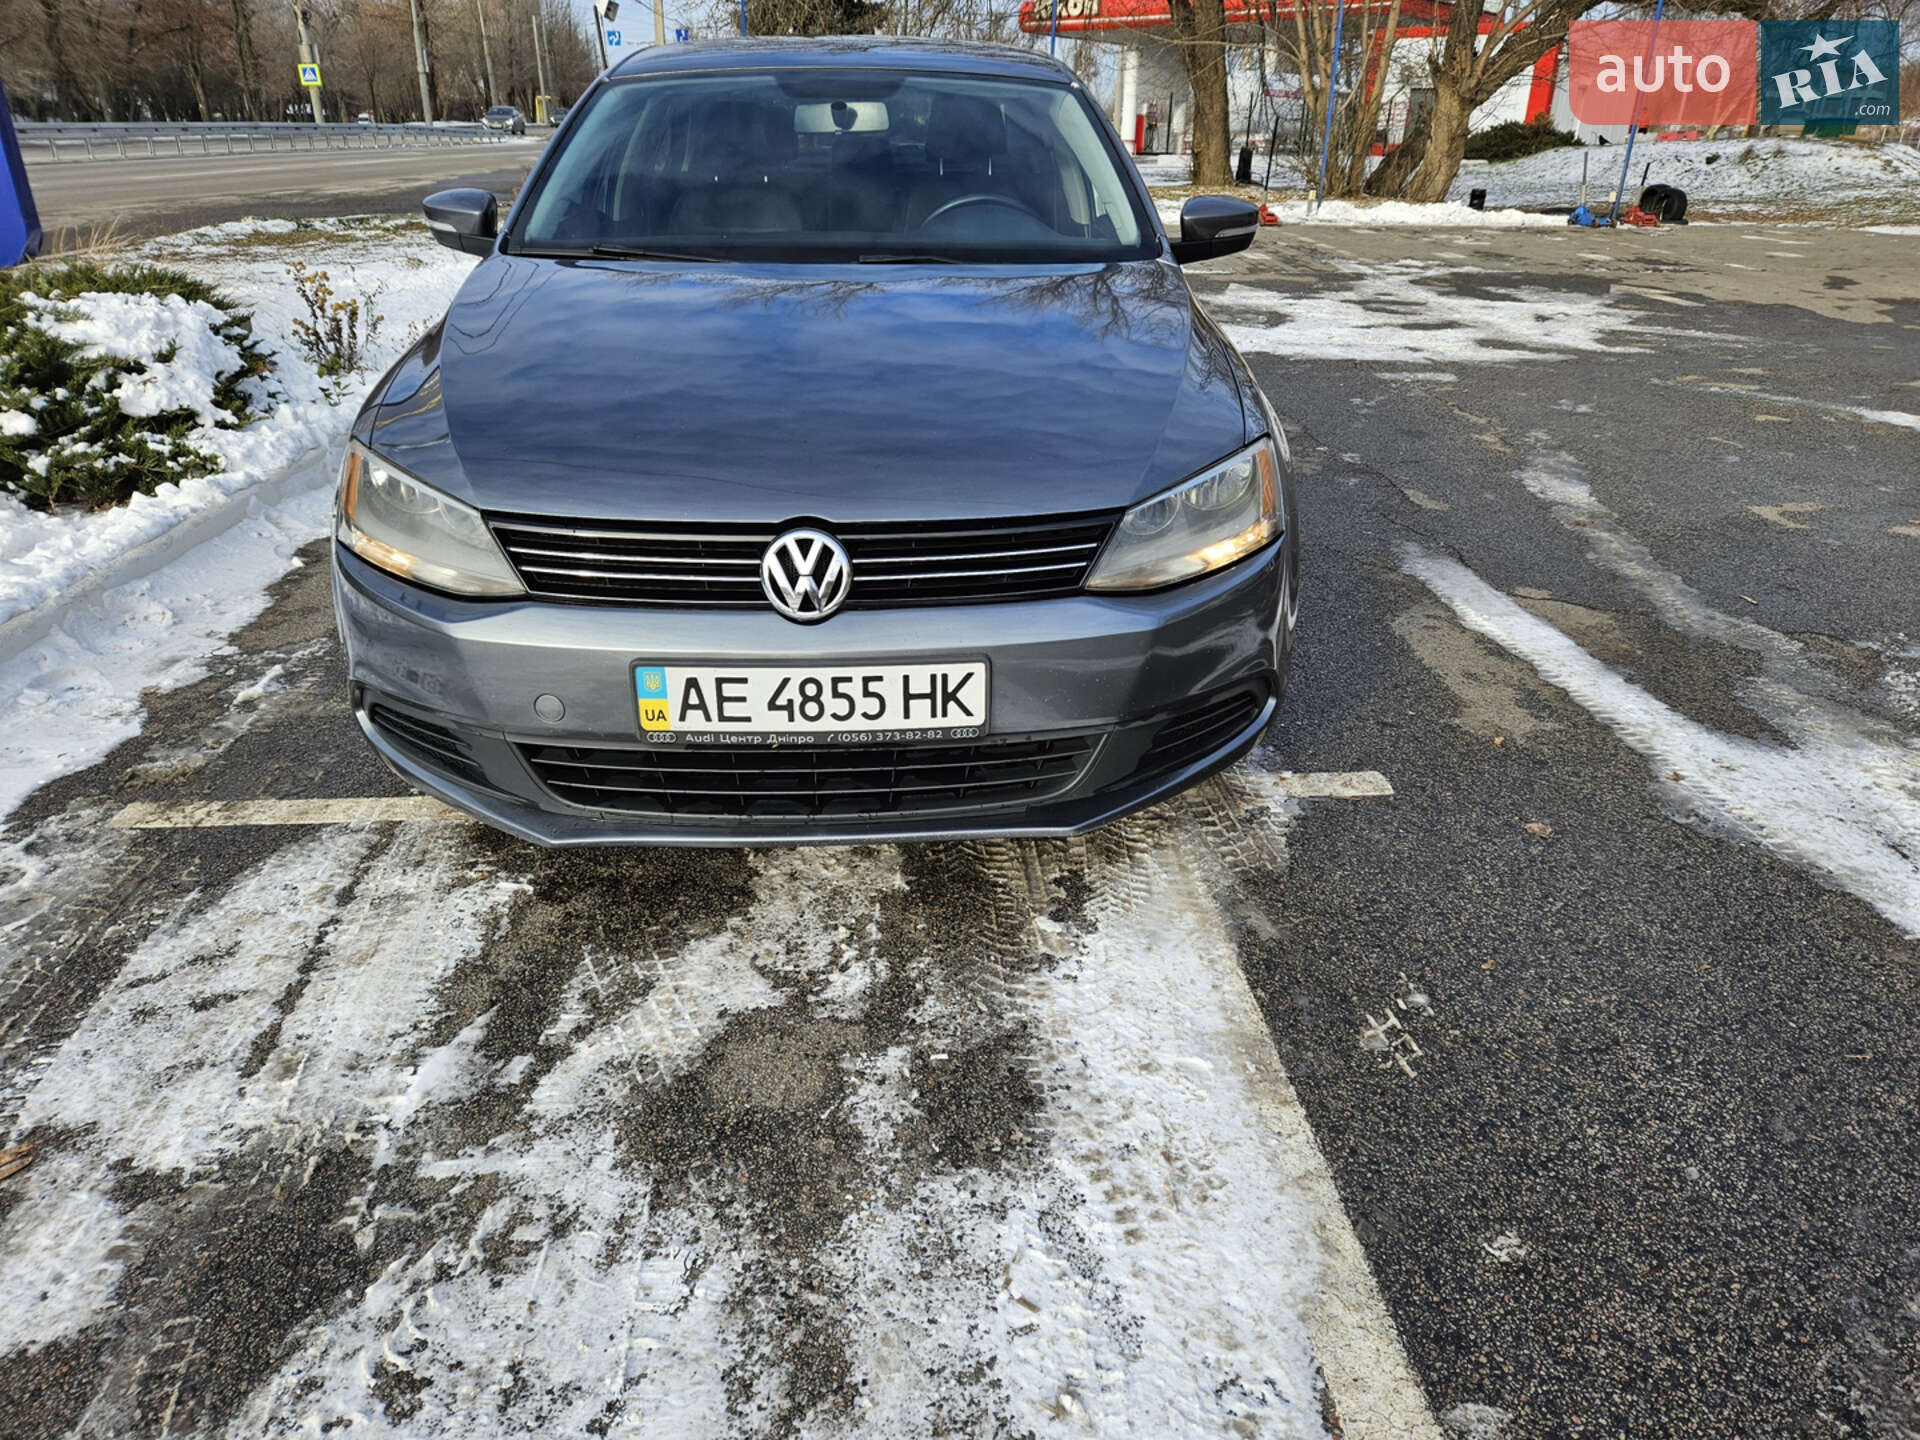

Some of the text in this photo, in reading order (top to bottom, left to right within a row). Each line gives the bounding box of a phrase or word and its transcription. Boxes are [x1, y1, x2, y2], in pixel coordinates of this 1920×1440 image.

[679, 672, 975, 722] AE 4855 HK
[645, 709, 667, 722] UA
[685, 730, 943, 745] Audi Центр Дніпро (056) 373-82-82
